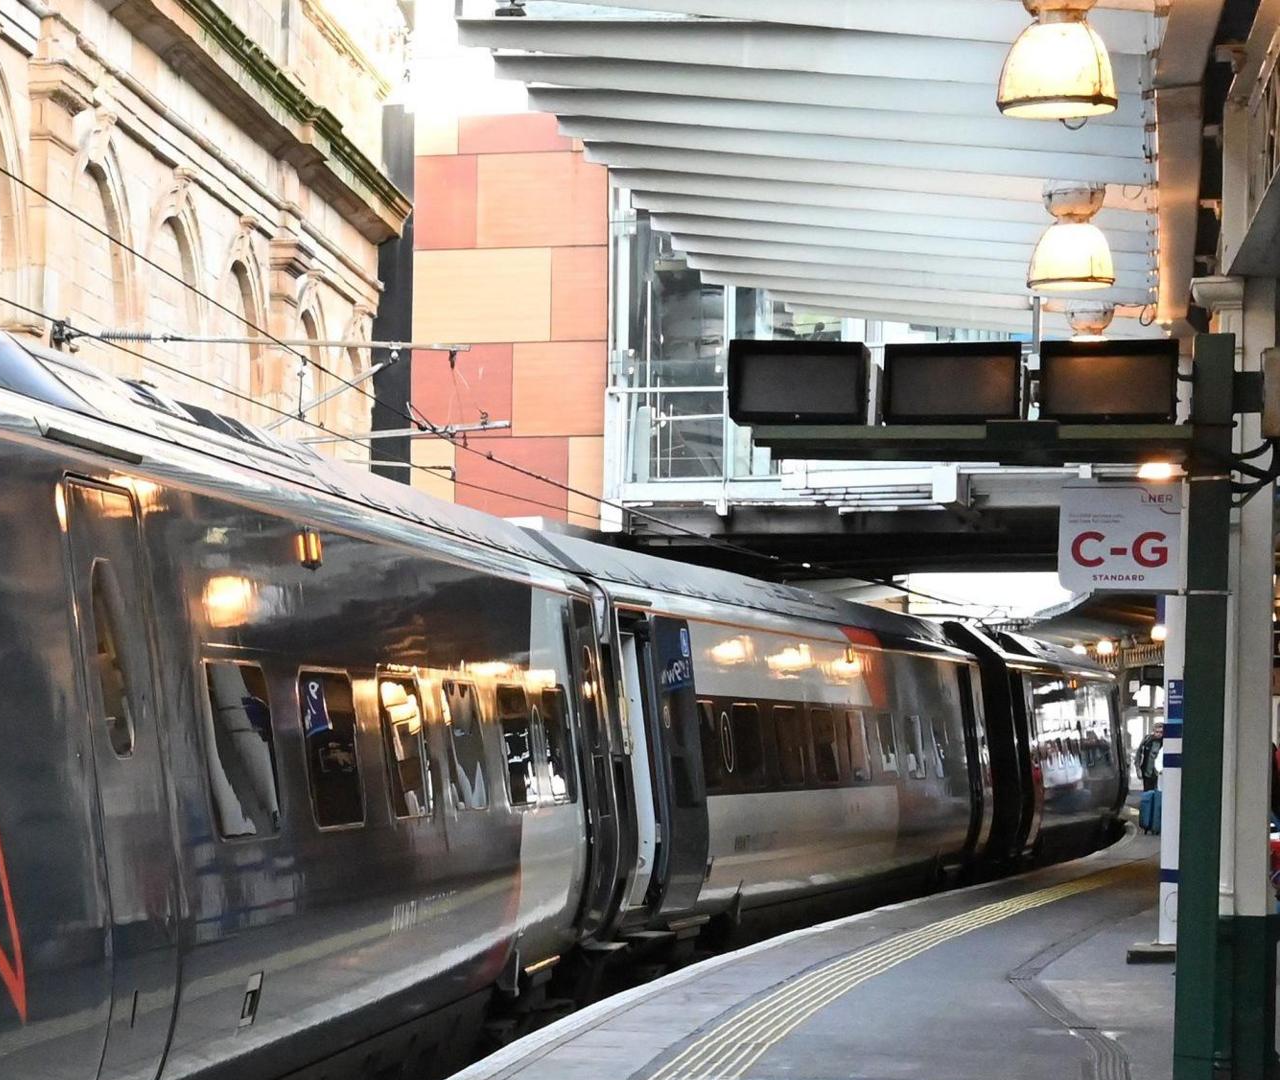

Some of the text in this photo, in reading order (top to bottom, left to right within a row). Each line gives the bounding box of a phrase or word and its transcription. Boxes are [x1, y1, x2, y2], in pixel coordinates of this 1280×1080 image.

[1141, 494, 1173, 504] LNER
[1071, 531, 1168, 568] C-G
[1092, 574, 1145, 582] STANDARD
